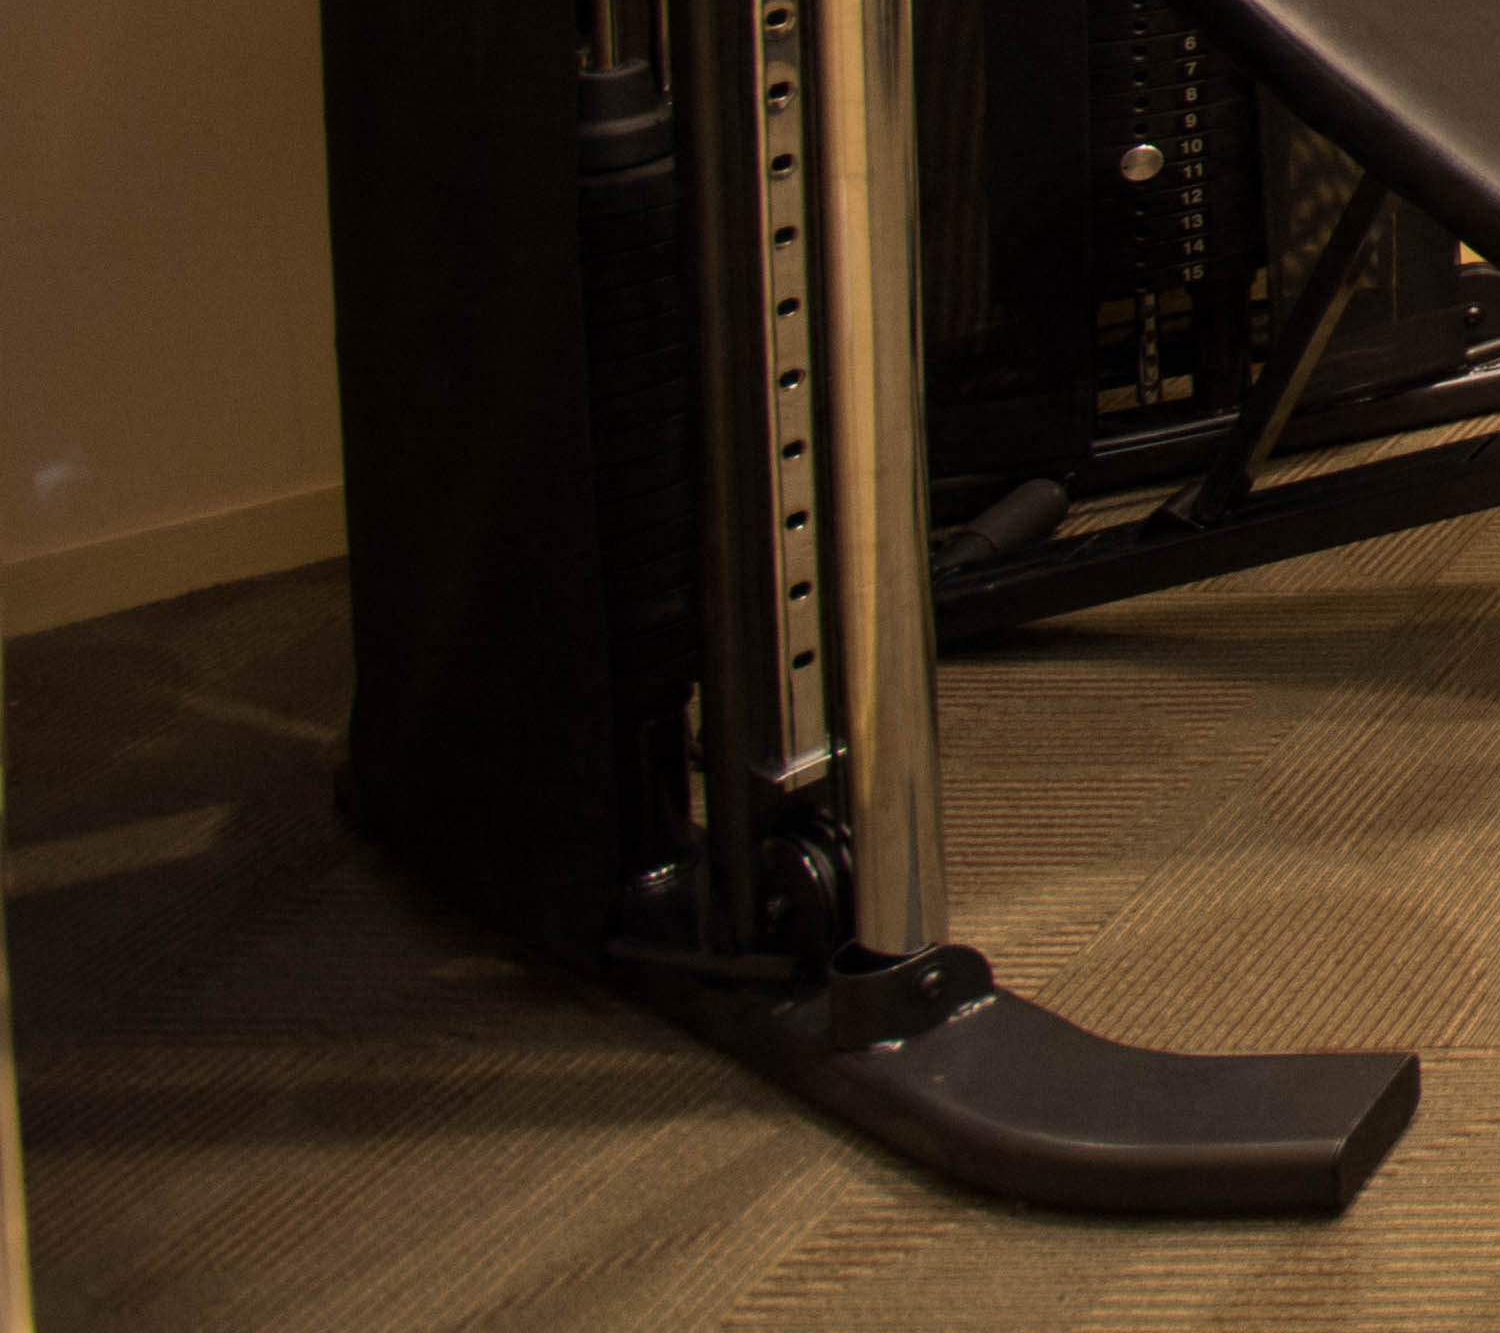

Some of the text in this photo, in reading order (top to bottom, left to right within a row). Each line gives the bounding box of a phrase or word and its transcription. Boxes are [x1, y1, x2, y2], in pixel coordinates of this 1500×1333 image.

[1183, 36, 1197, 52] 6
[1184, 61, 1198, 77] 7
[1184, 86, 1198, 102] 8
[1184, 112, 1197, 128] 9
[1180, 137, 1203, 154] 10
[1183, 162, 1203, 179] 11
[1181, 188, 1203, 205] 12
[1181, 213, 1204, 230] 13
[1183, 238, 1205, 255] 14
[1182, 264, 1204, 281] 15
